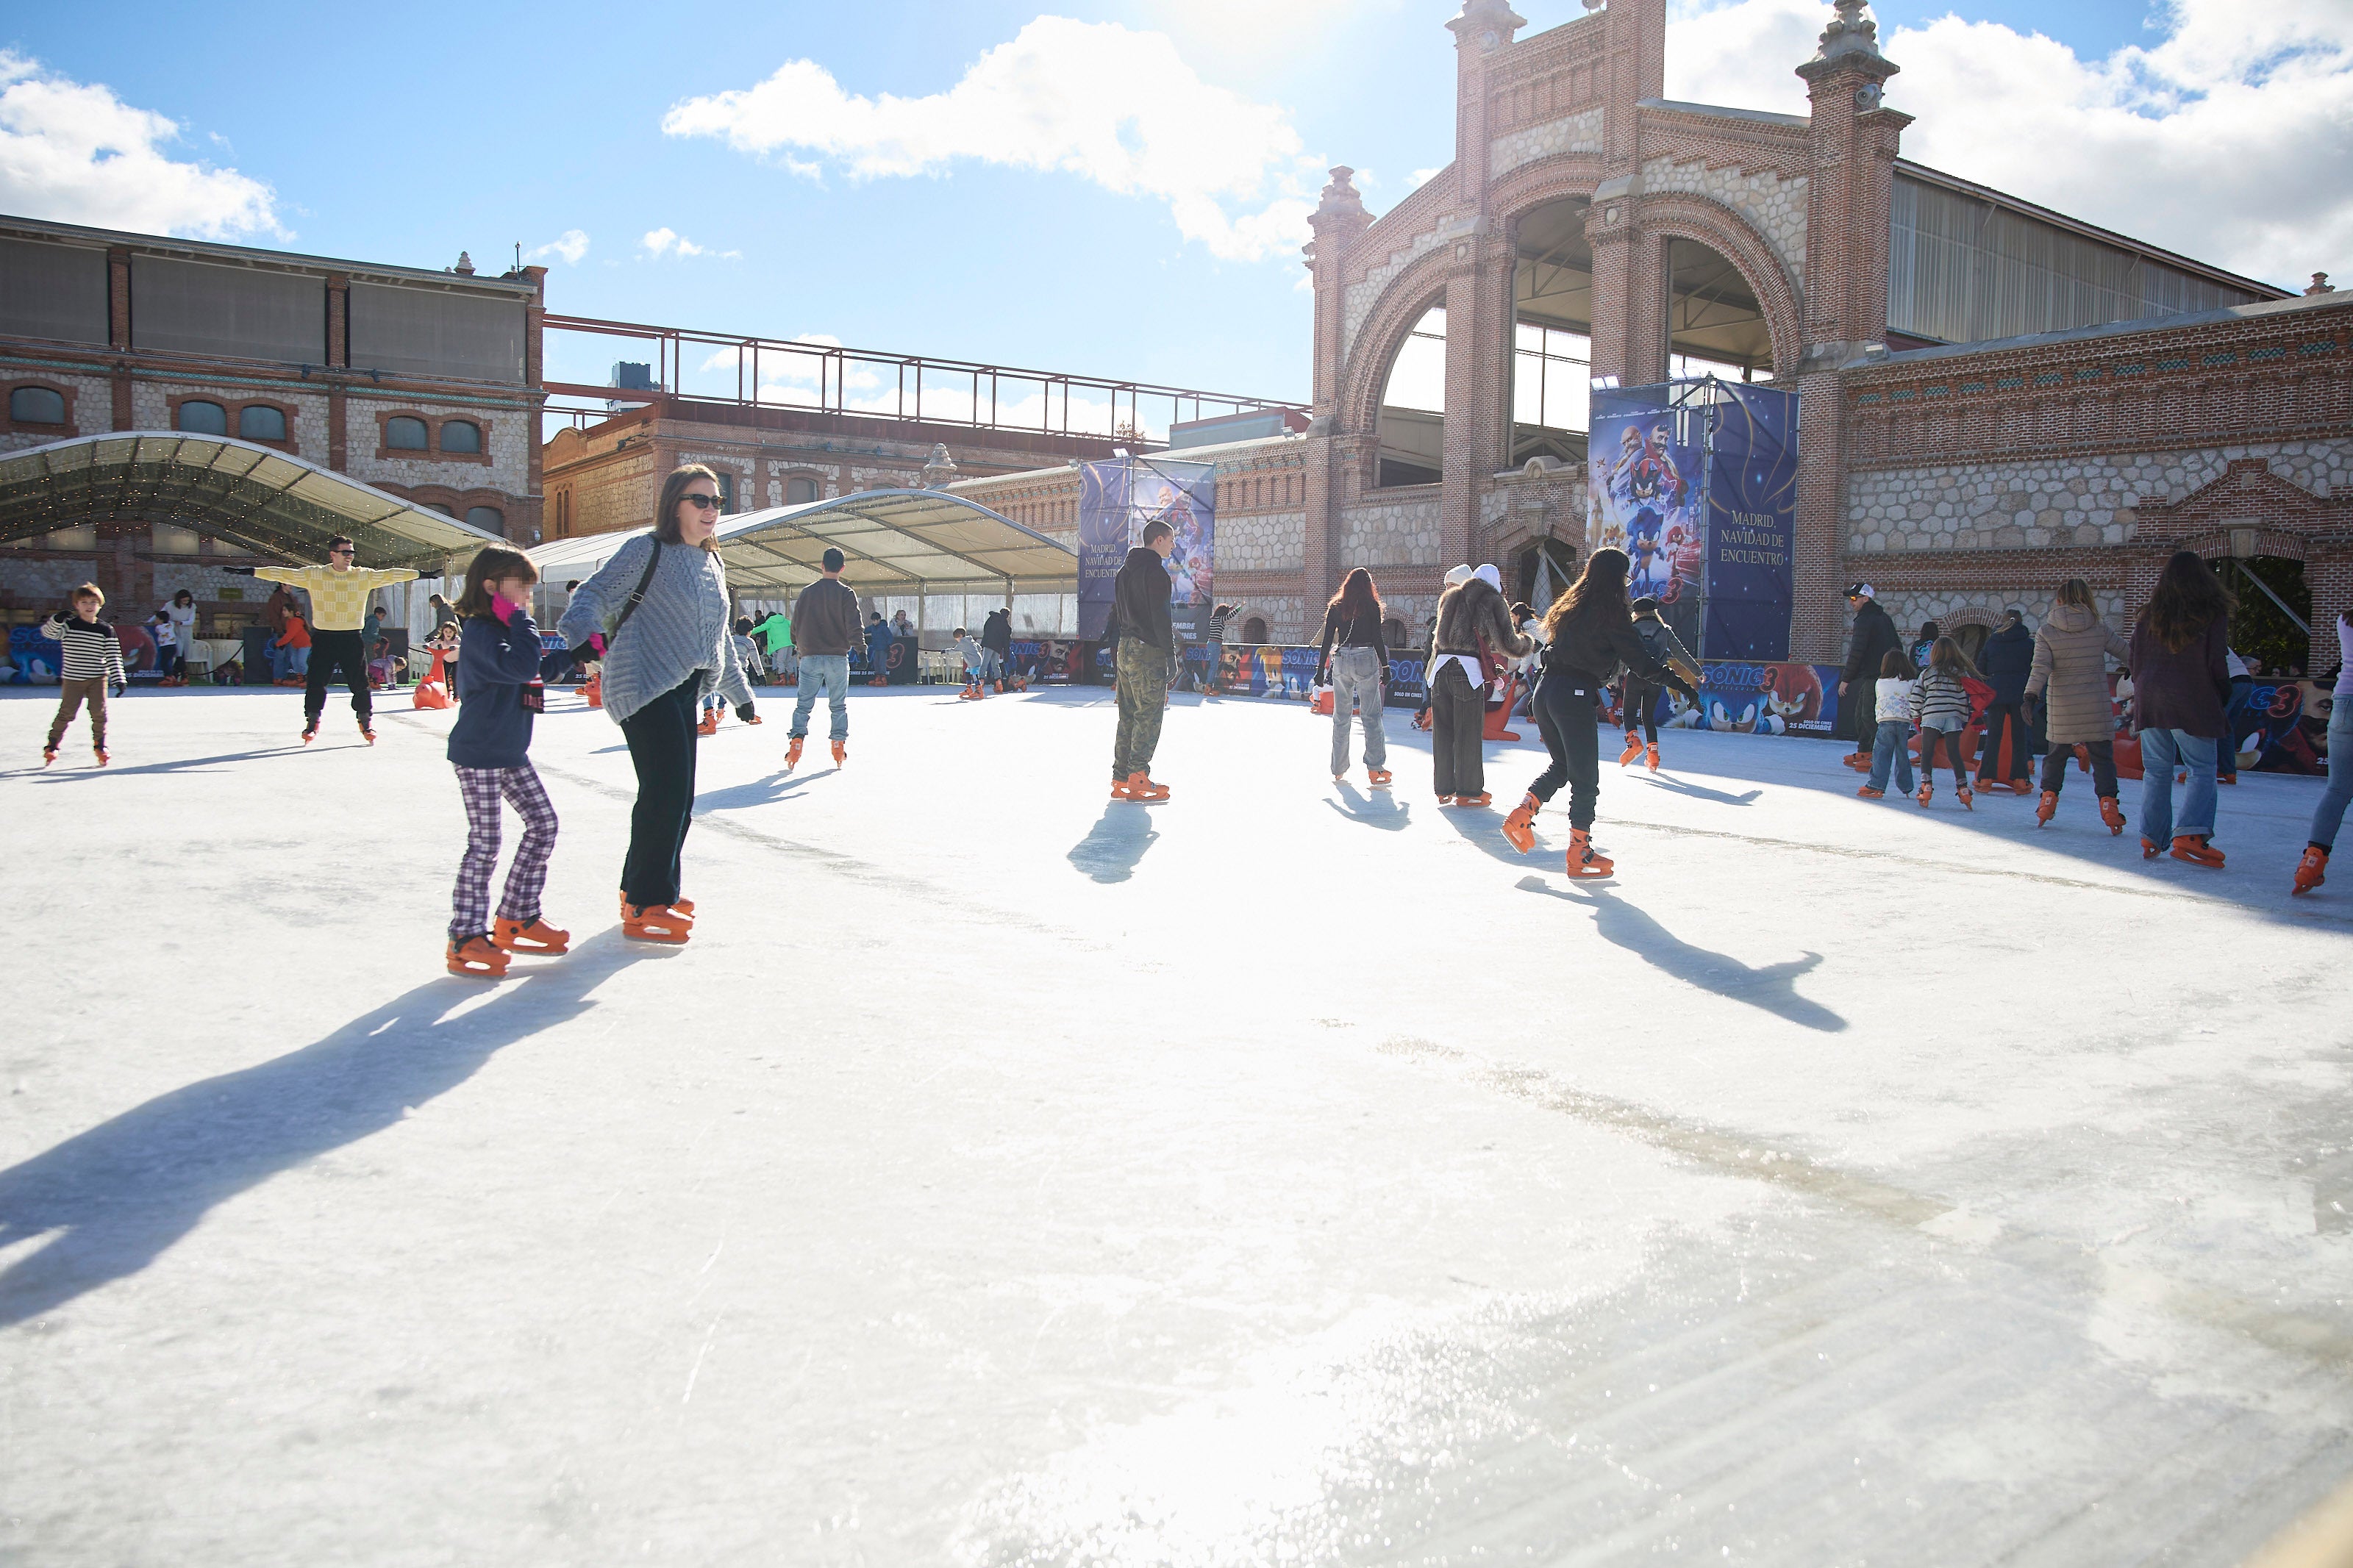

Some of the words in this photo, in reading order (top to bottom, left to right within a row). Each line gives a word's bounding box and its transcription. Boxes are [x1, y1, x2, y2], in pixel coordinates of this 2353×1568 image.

[1721, 529, 1770, 545] NAVIDAD
[1771, 534, 1785, 548] DE
[1085, 556, 1113, 565] NAVIDAD
[1114, 556, 1122, 565] DE
[1721, 548, 1784, 566] ENCUENTRO
[1085, 569, 1118, 578] ENCUENTR
[1661, 576, 1684, 605] 3
[1173, 622, 1196, 630] EMBRE
[1010, 642, 1040, 655] ONIC
[1186, 647, 1210, 661] SON
[1282, 649, 1321, 665] SONIC
[1388, 659, 1424, 682] SON
[1701, 665, 1765, 687] SONIC
[1759, 666, 1779, 692] 3
[1799, 723, 1832, 731] DICIEMBRE
